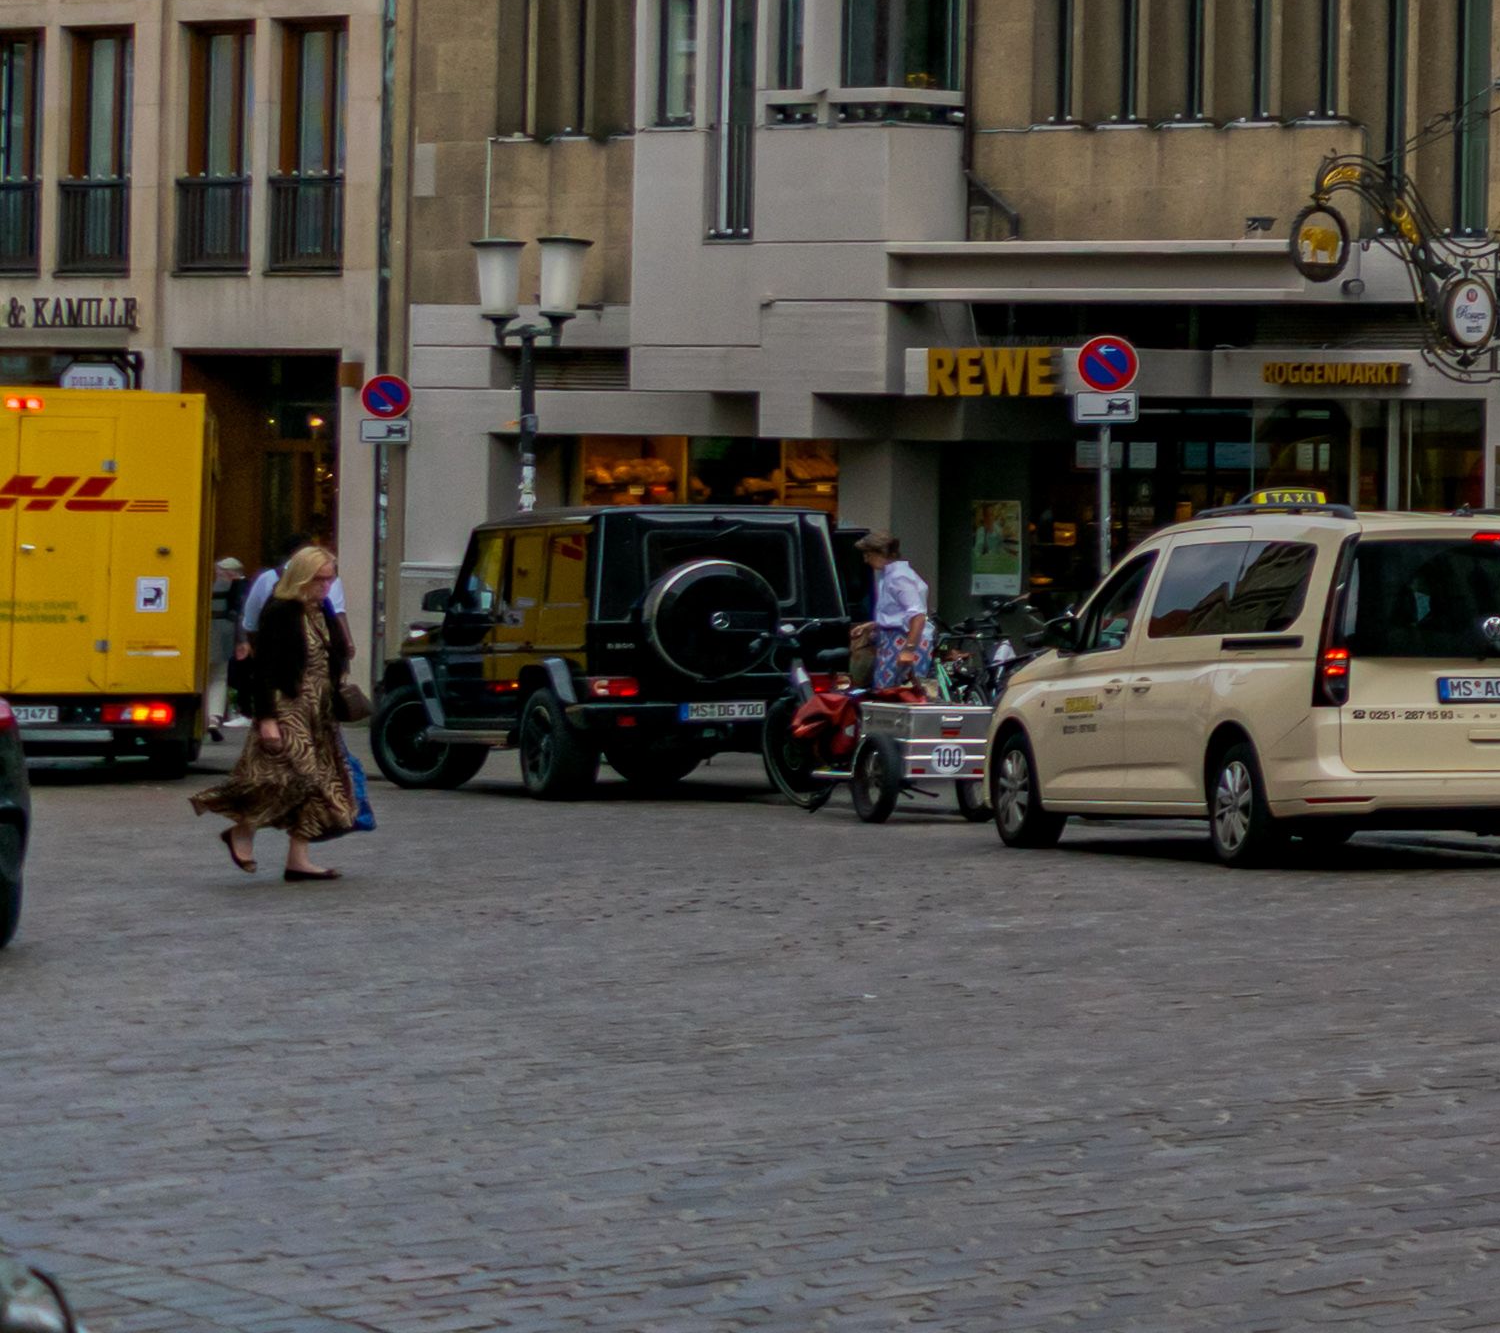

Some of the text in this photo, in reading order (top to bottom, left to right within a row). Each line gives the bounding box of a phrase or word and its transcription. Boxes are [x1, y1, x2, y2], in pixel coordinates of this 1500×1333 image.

[8, 297, 138, 329] & KAMILLE
[927, 347, 1060, 396] REWE
[1263, 362, 1401, 383] ROGGENMARKT
[1271, 493, 1313, 503] TAXI
[1450, 681, 1474, 697] MS
[689, 702, 764, 717] MS DG 700
[935, 747, 963, 767] 100
